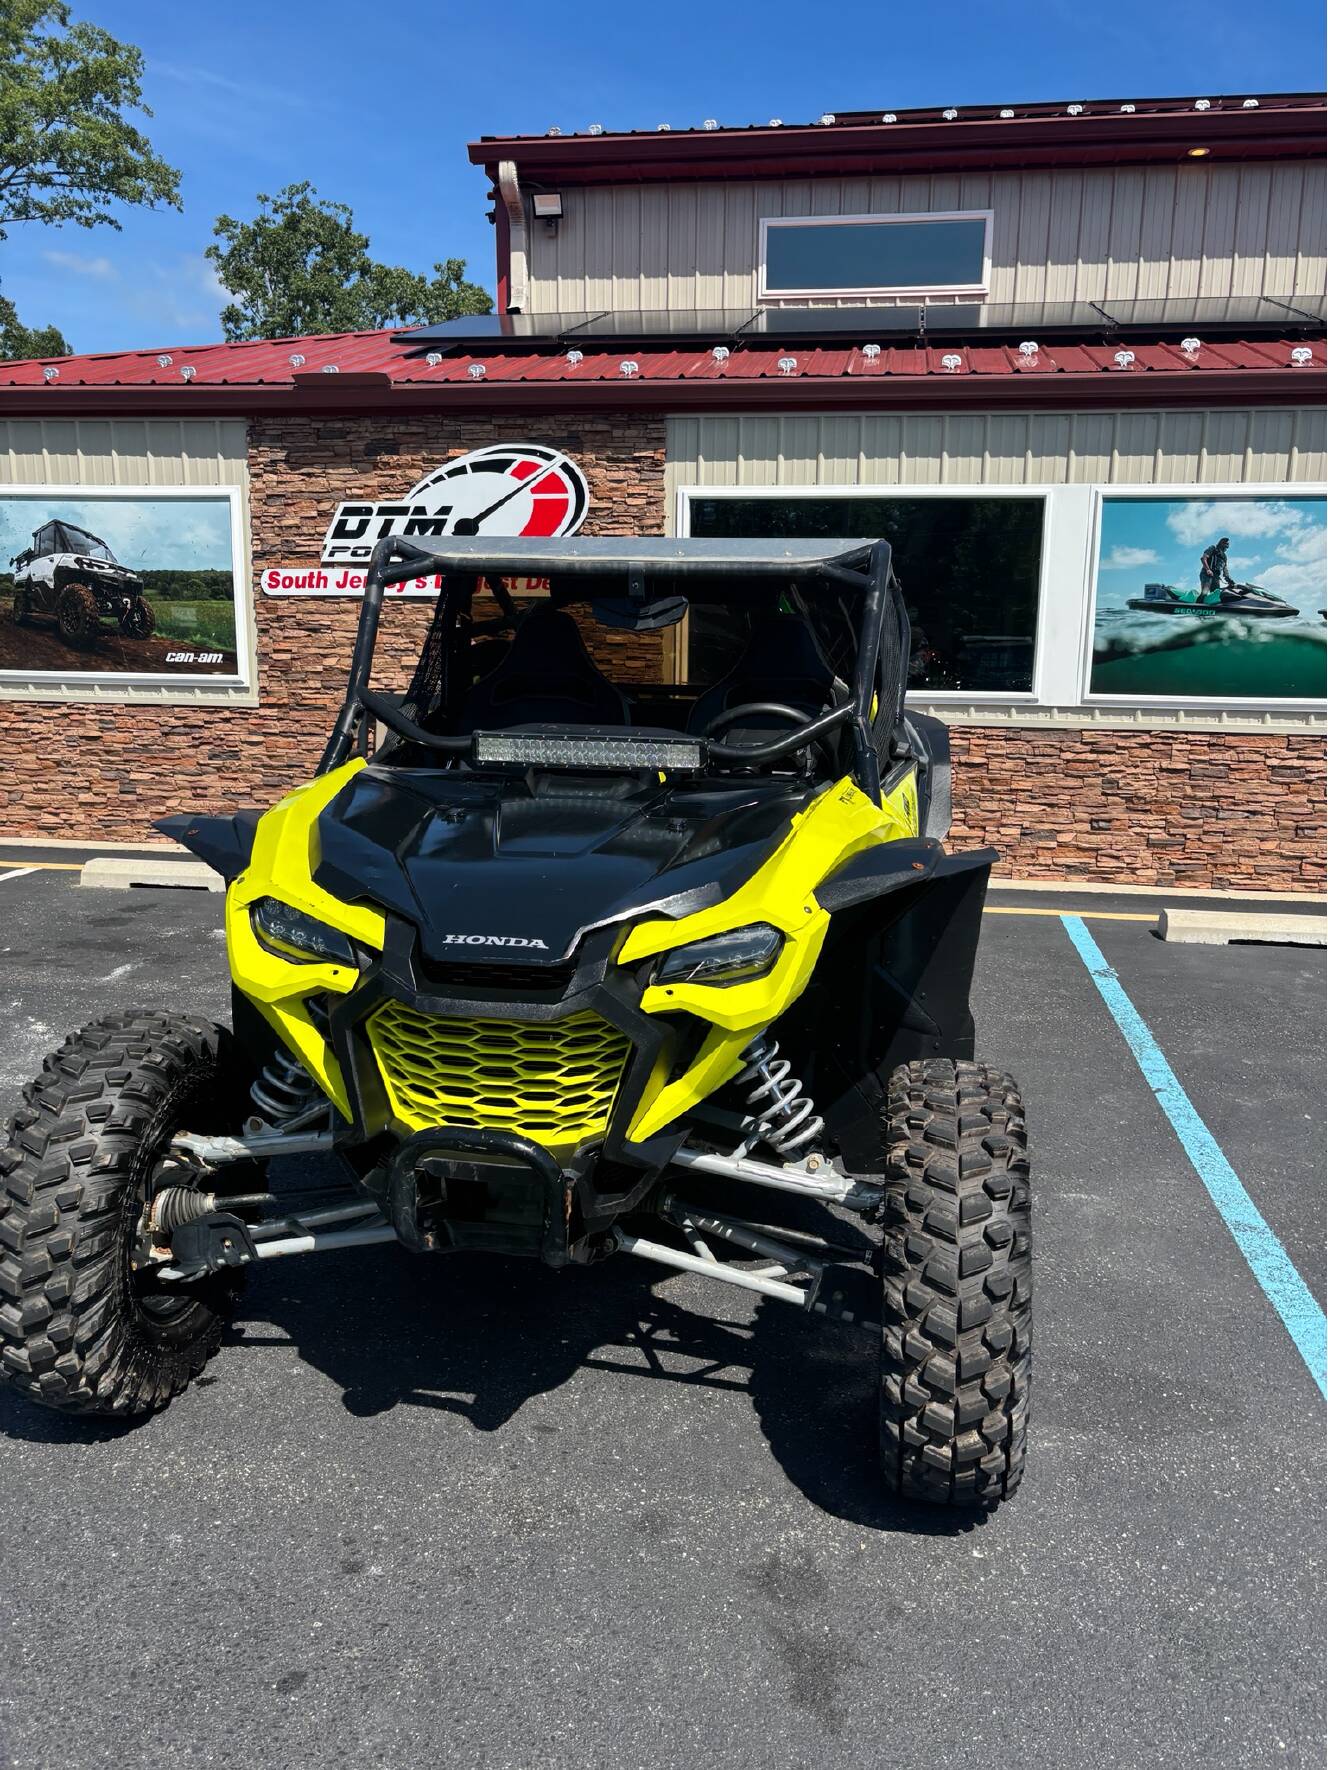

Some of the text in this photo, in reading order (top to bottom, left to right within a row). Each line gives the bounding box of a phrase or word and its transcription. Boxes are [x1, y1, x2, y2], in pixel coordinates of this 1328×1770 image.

[331, 505, 453, 539] DTM
[327, 546, 373, 557] PO
[267, 571, 328, 589] South
[165, 652, 223, 663] can-am
[442, 934, 549, 950] HONDA
